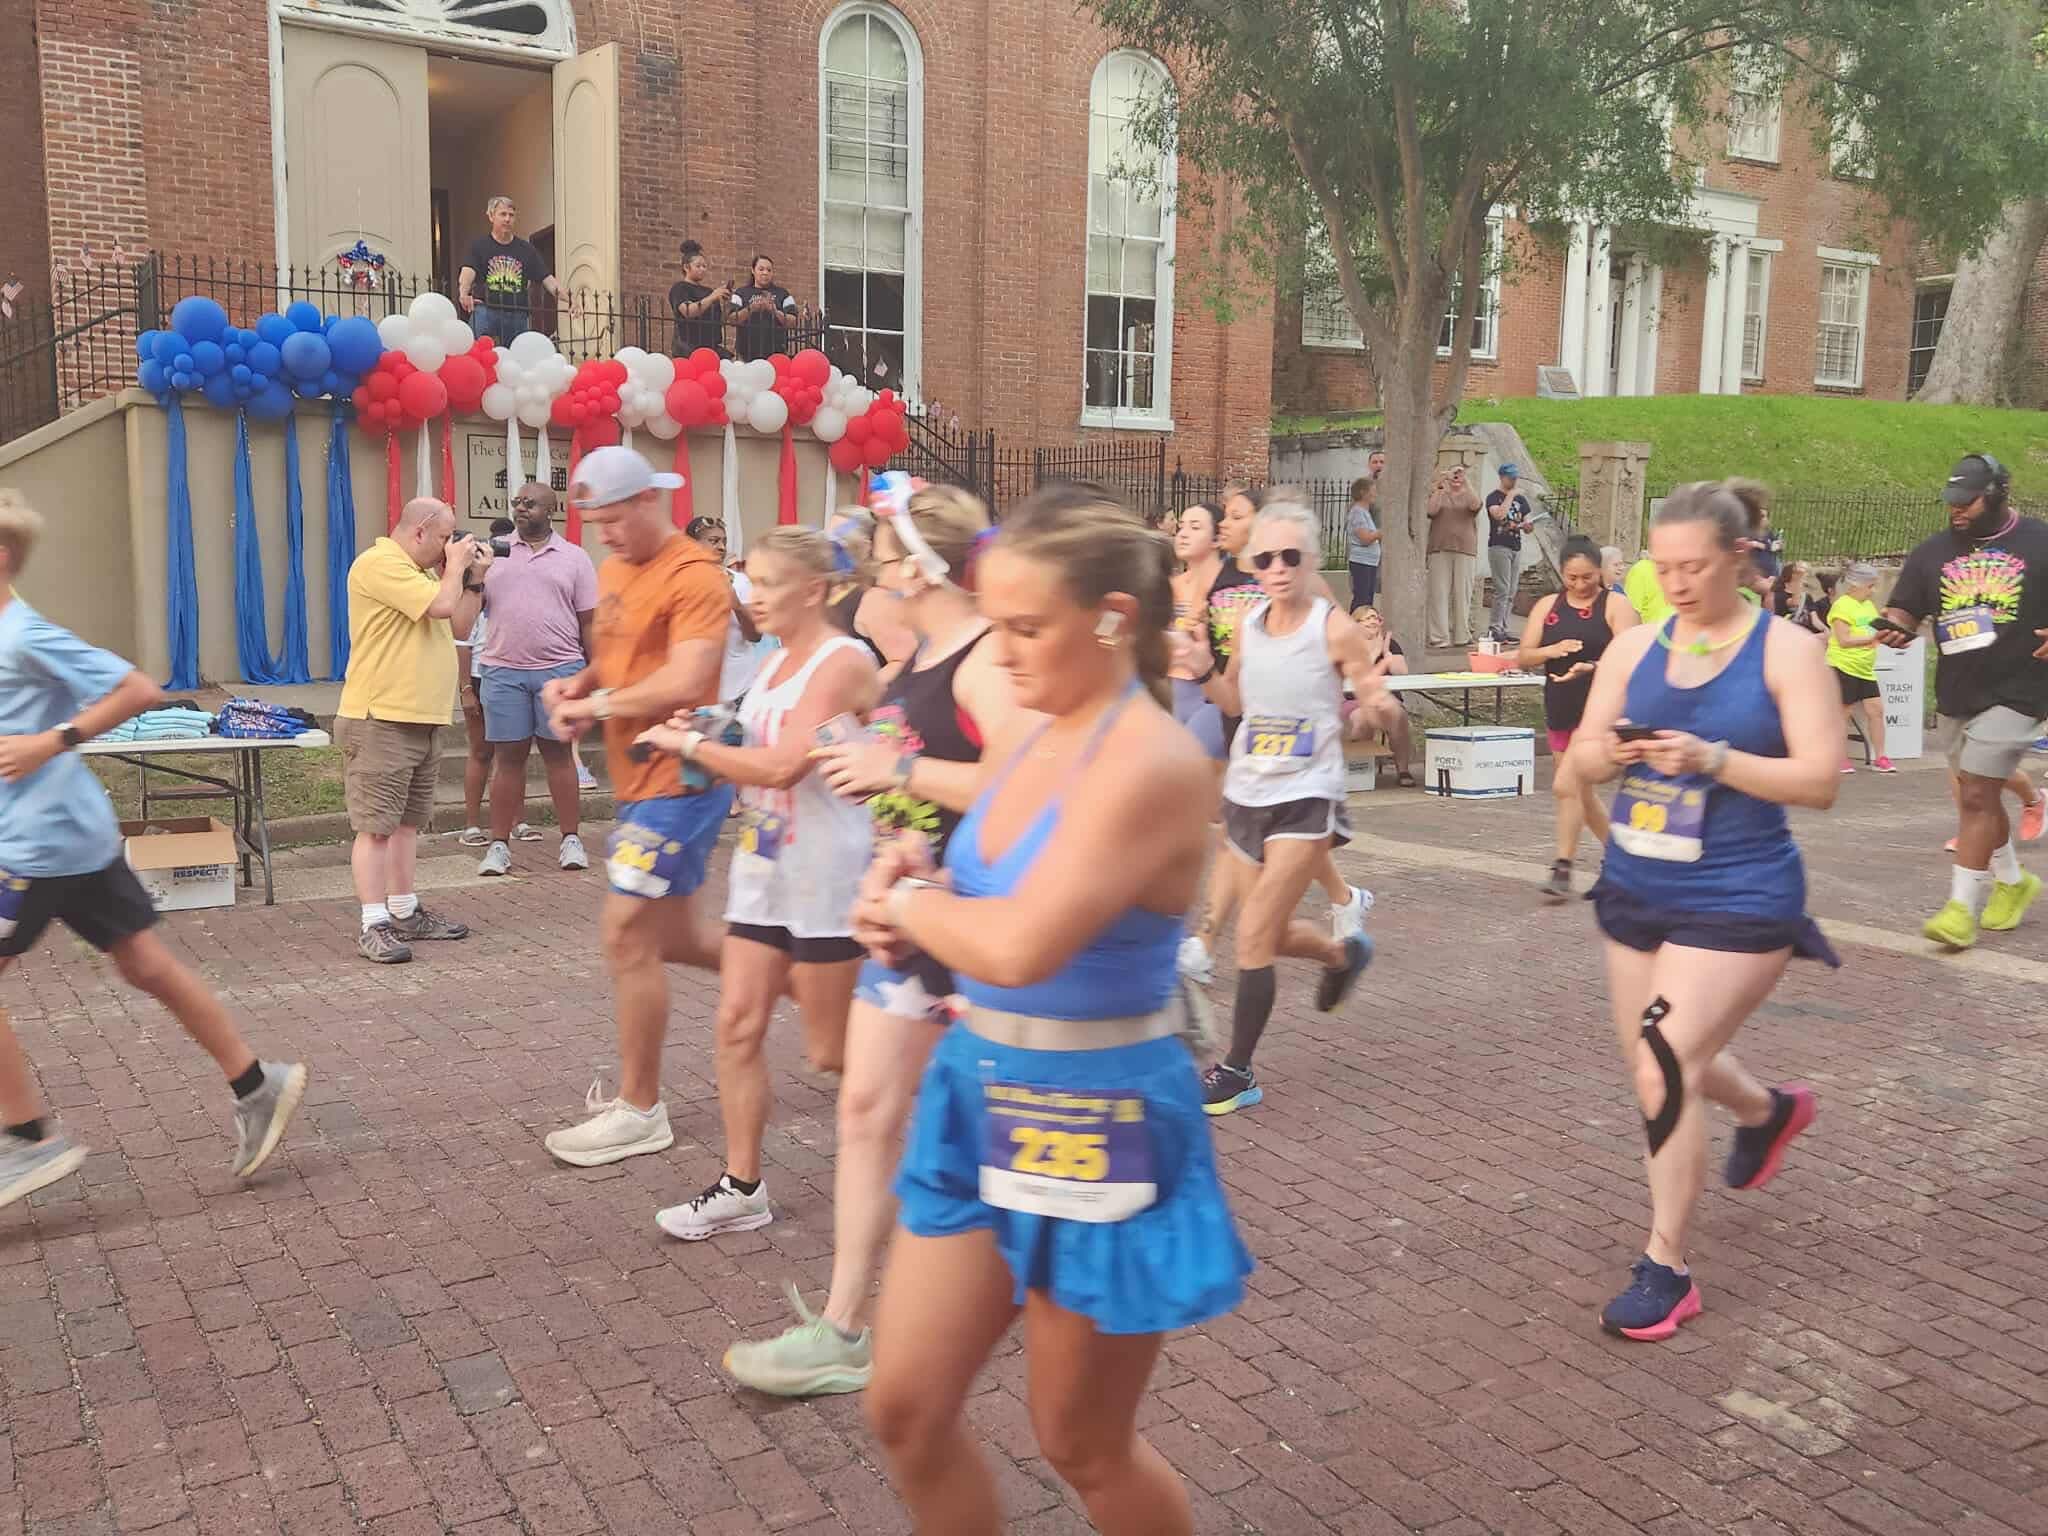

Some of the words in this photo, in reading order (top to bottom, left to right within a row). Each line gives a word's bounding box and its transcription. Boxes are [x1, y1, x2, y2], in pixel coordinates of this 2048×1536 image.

[471, 441, 494, 456] The
[1886, 683, 1912, 692] TRASH
[1887, 695, 1910, 704] ONLY
[1474, 761, 1493, 769] PORT
[1495, 759, 1532, 769] AUTHORITY
[173, 868, 218, 878] RESPECT
[1009, 1127, 1110, 1181] 235
